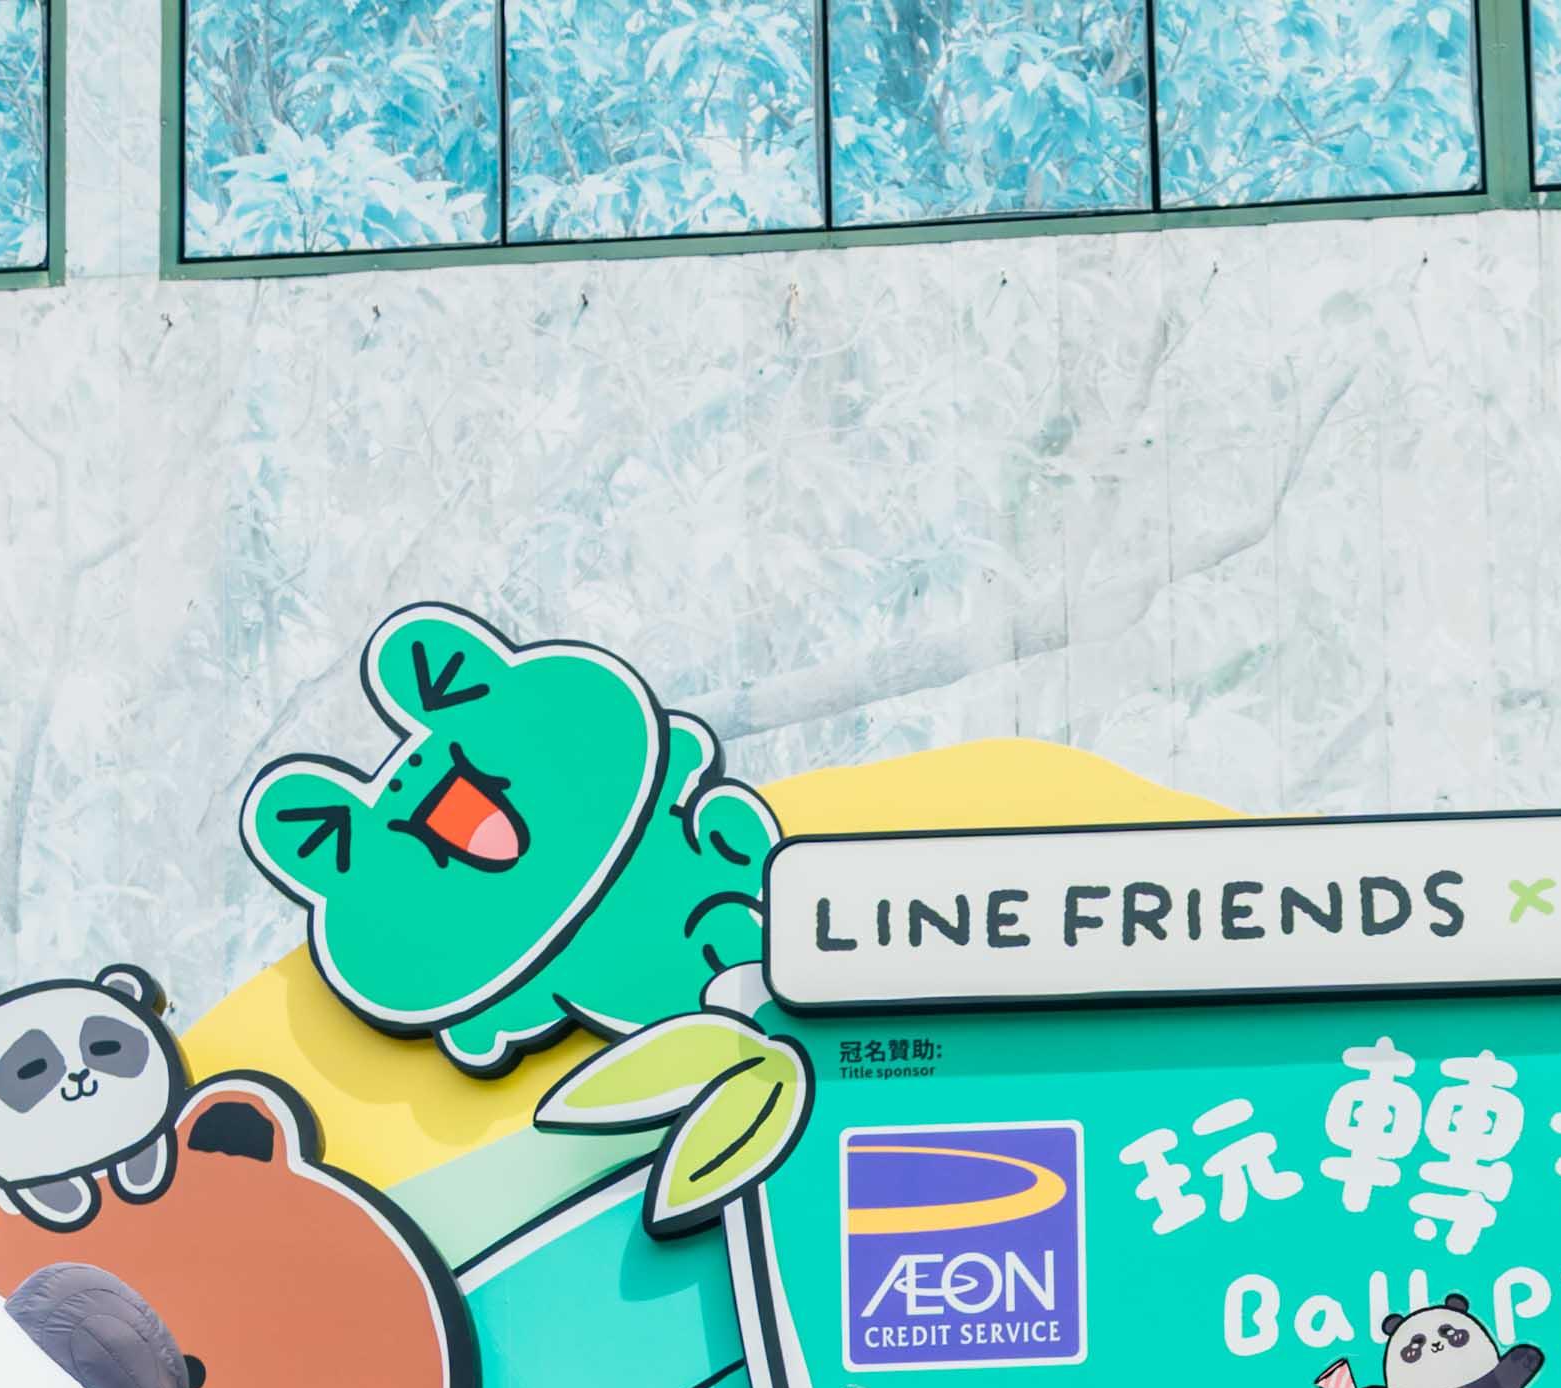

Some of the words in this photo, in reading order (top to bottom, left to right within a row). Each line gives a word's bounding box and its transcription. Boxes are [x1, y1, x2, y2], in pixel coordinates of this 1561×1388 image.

[815, 889, 1032, 953] LINE
[1063, 870, 1466, 948] FRIENDS
[840, 1067, 873, 1080] Title
[876, 1066, 935, 1081] sponsor
[864, 1325, 952, 1349] CREDIT
[960, 1321, 1062, 1346] SERVICE
